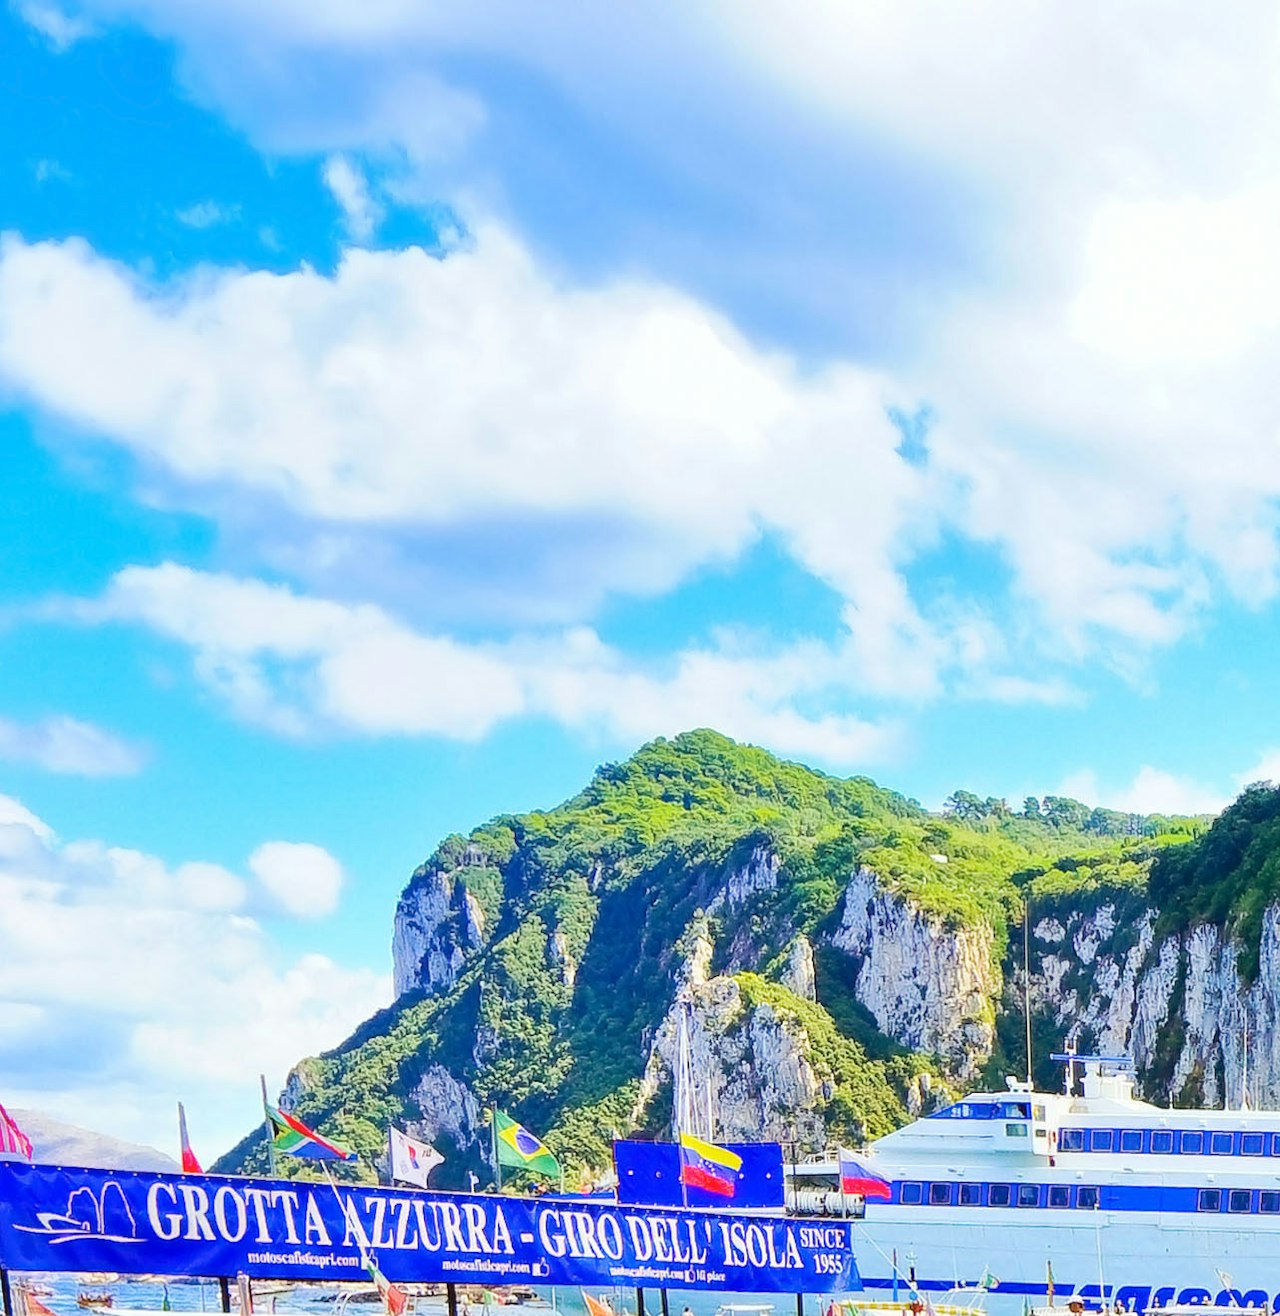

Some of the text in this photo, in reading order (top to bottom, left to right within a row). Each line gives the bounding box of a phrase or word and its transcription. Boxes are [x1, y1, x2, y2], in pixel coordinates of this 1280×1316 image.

[147, 1182, 332, 1246] GROTTA
[342, 1194, 515, 1254] AZZURRA
[539, 1209, 624, 1260] GIRO
[625, 1215, 712, 1264] DELL'
[718, 1222, 804, 1269] ISOLA
[799, 1228, 845, 1249] SINCE
[813, 1253, 844, 1275] 1955
